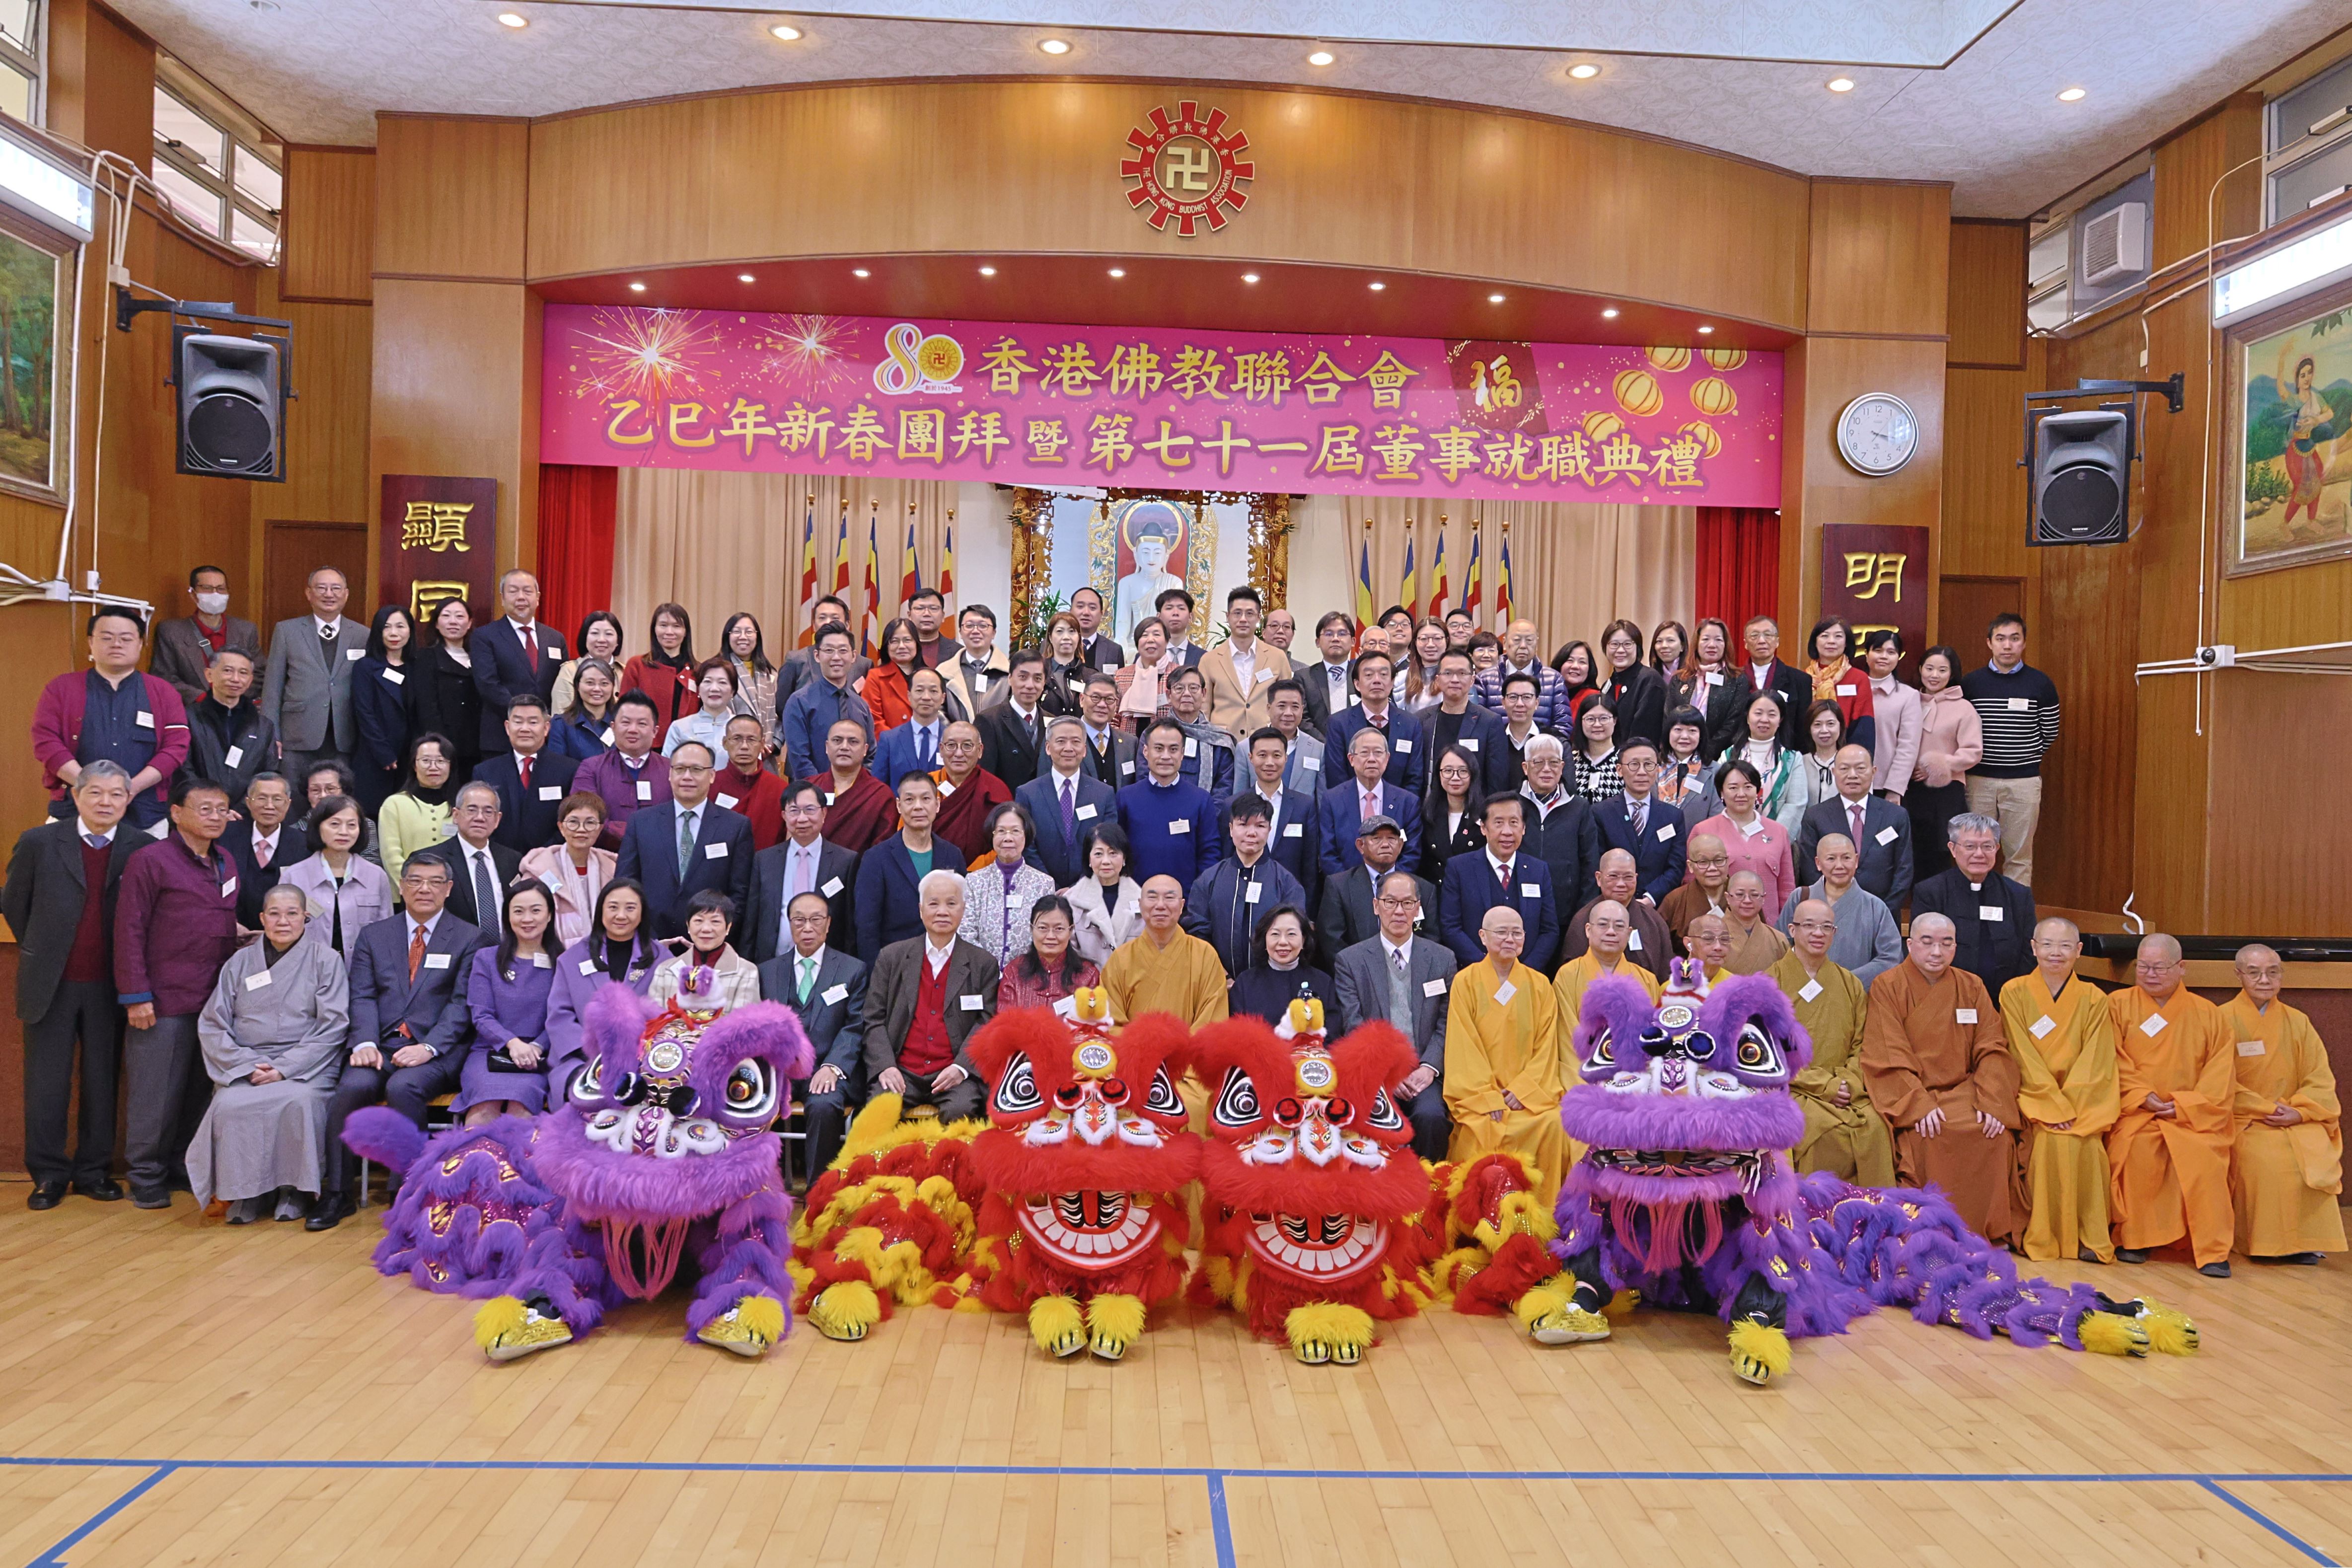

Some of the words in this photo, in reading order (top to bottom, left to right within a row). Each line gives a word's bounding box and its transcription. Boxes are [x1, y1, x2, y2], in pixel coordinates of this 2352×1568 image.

[1146, 180, 1159, 197] HONG
[1159, 197, 1175, 211] KONG
[1179, 203, 1208, 214] BUDDHIST
[1210, 169, 1233, 205] ASSOCIATION
[975, 338, 1419, 409] 香港佛教聯合會
[1470, 355, 1522, 412] 福
